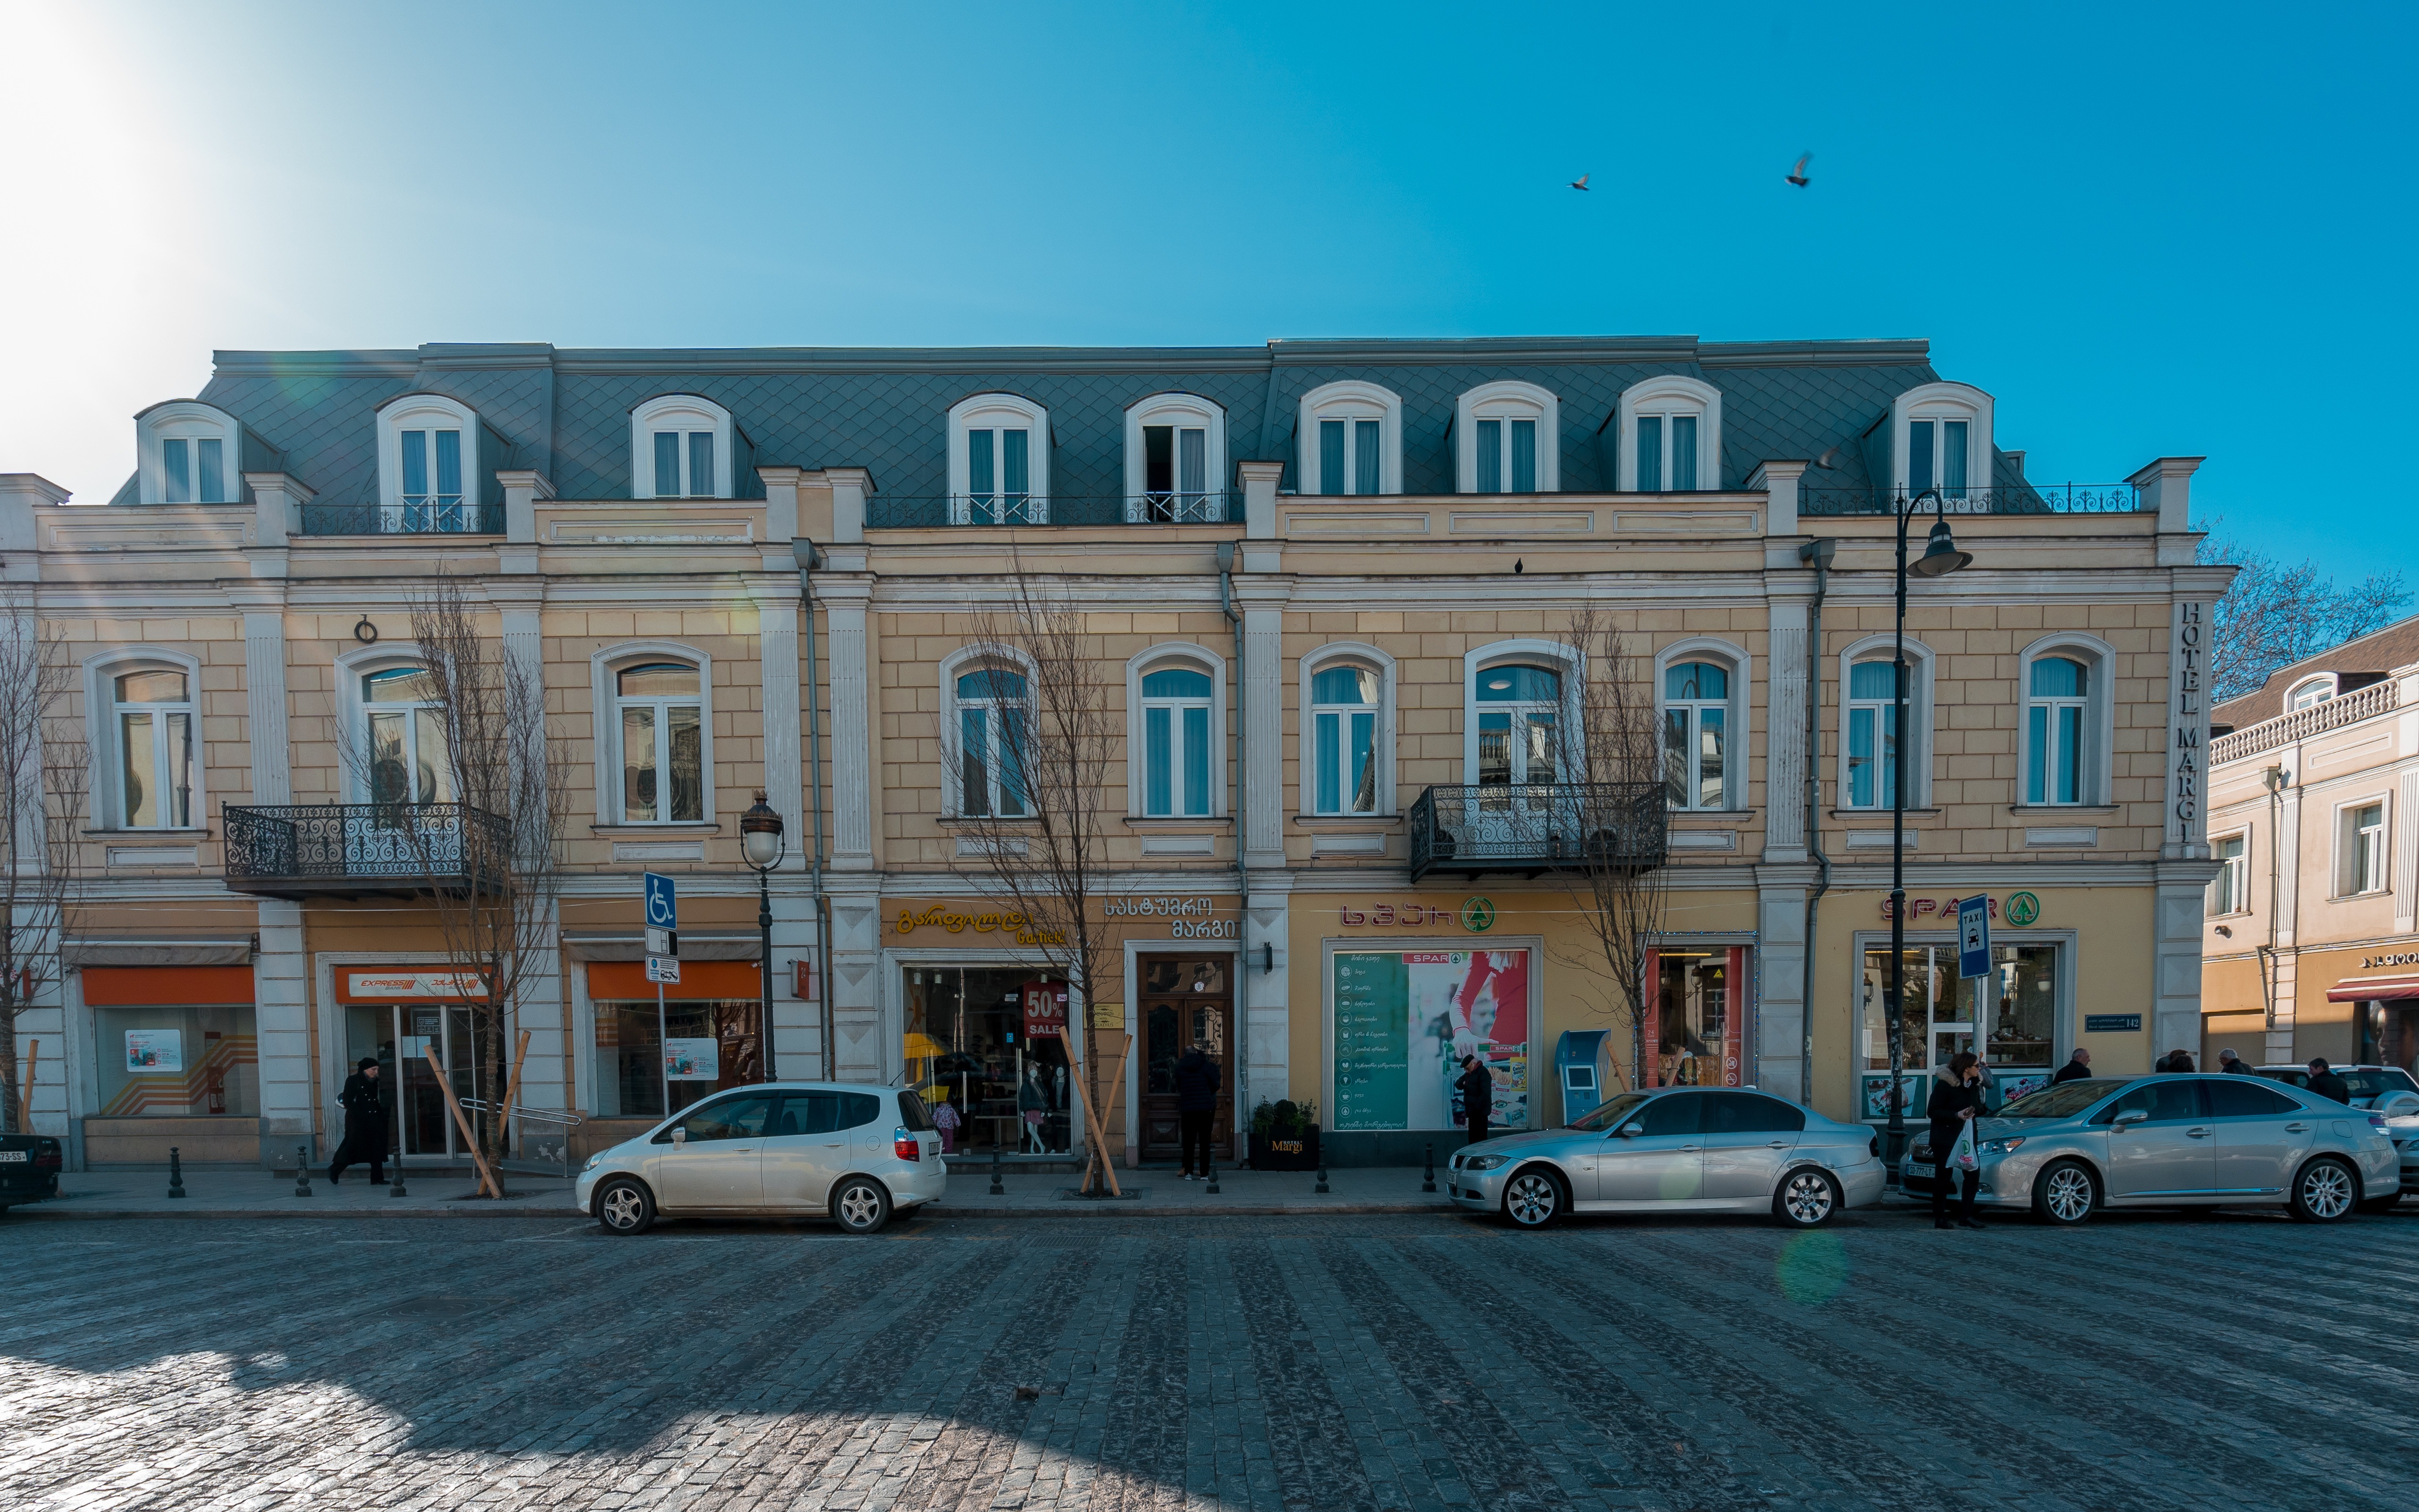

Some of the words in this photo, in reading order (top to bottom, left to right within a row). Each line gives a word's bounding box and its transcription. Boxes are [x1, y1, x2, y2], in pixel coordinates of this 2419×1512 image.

[2182, 603, 2203, 714] HOTEL
[2177, 727, 2200, 843] MARGI
[1104, 898, 1211, 916] სასტუმრო
[1963, 912, 1982, 924] TAXI
[1016, 928, 1067, 944] Garfield
[1172, 919, 1235, 938] მარგი
[801, 967, 806, 979] 24
[1028, 991, 1062, 1017] 50%
[1030, 1025, 1060, 1034] SALE
[2127, 1018, 2139, 1027] 142
[1272, 1140, 1302, 1154] Margi
[0, 1152, 21, 1161] 73-SS
